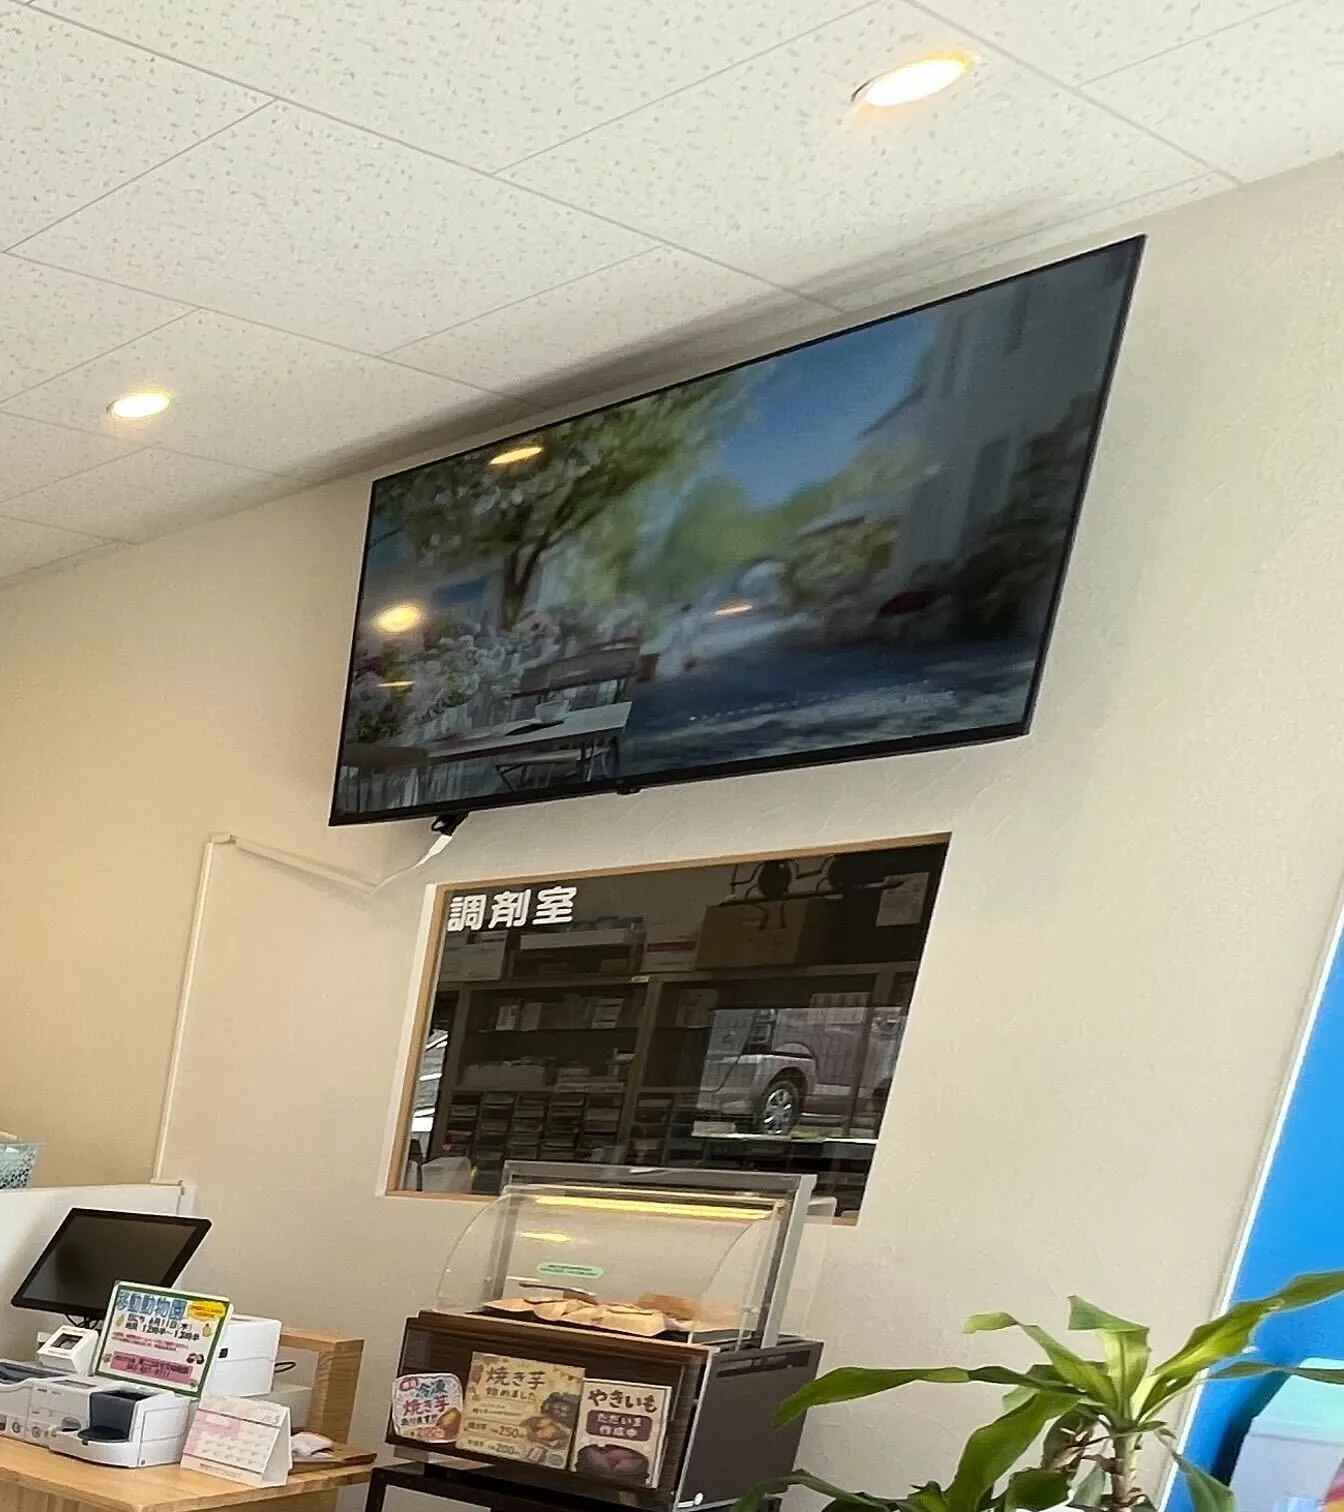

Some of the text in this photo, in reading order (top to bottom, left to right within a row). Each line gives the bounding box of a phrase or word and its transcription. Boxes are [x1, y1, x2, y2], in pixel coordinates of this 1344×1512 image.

[447, 886, 577, 932] 調剤室
[486, 1365, 546, 1391] 焼き芋
[403, 1394, 451, 1417] 焼き芋
[587, 1388, 658, 1413] やきいも
